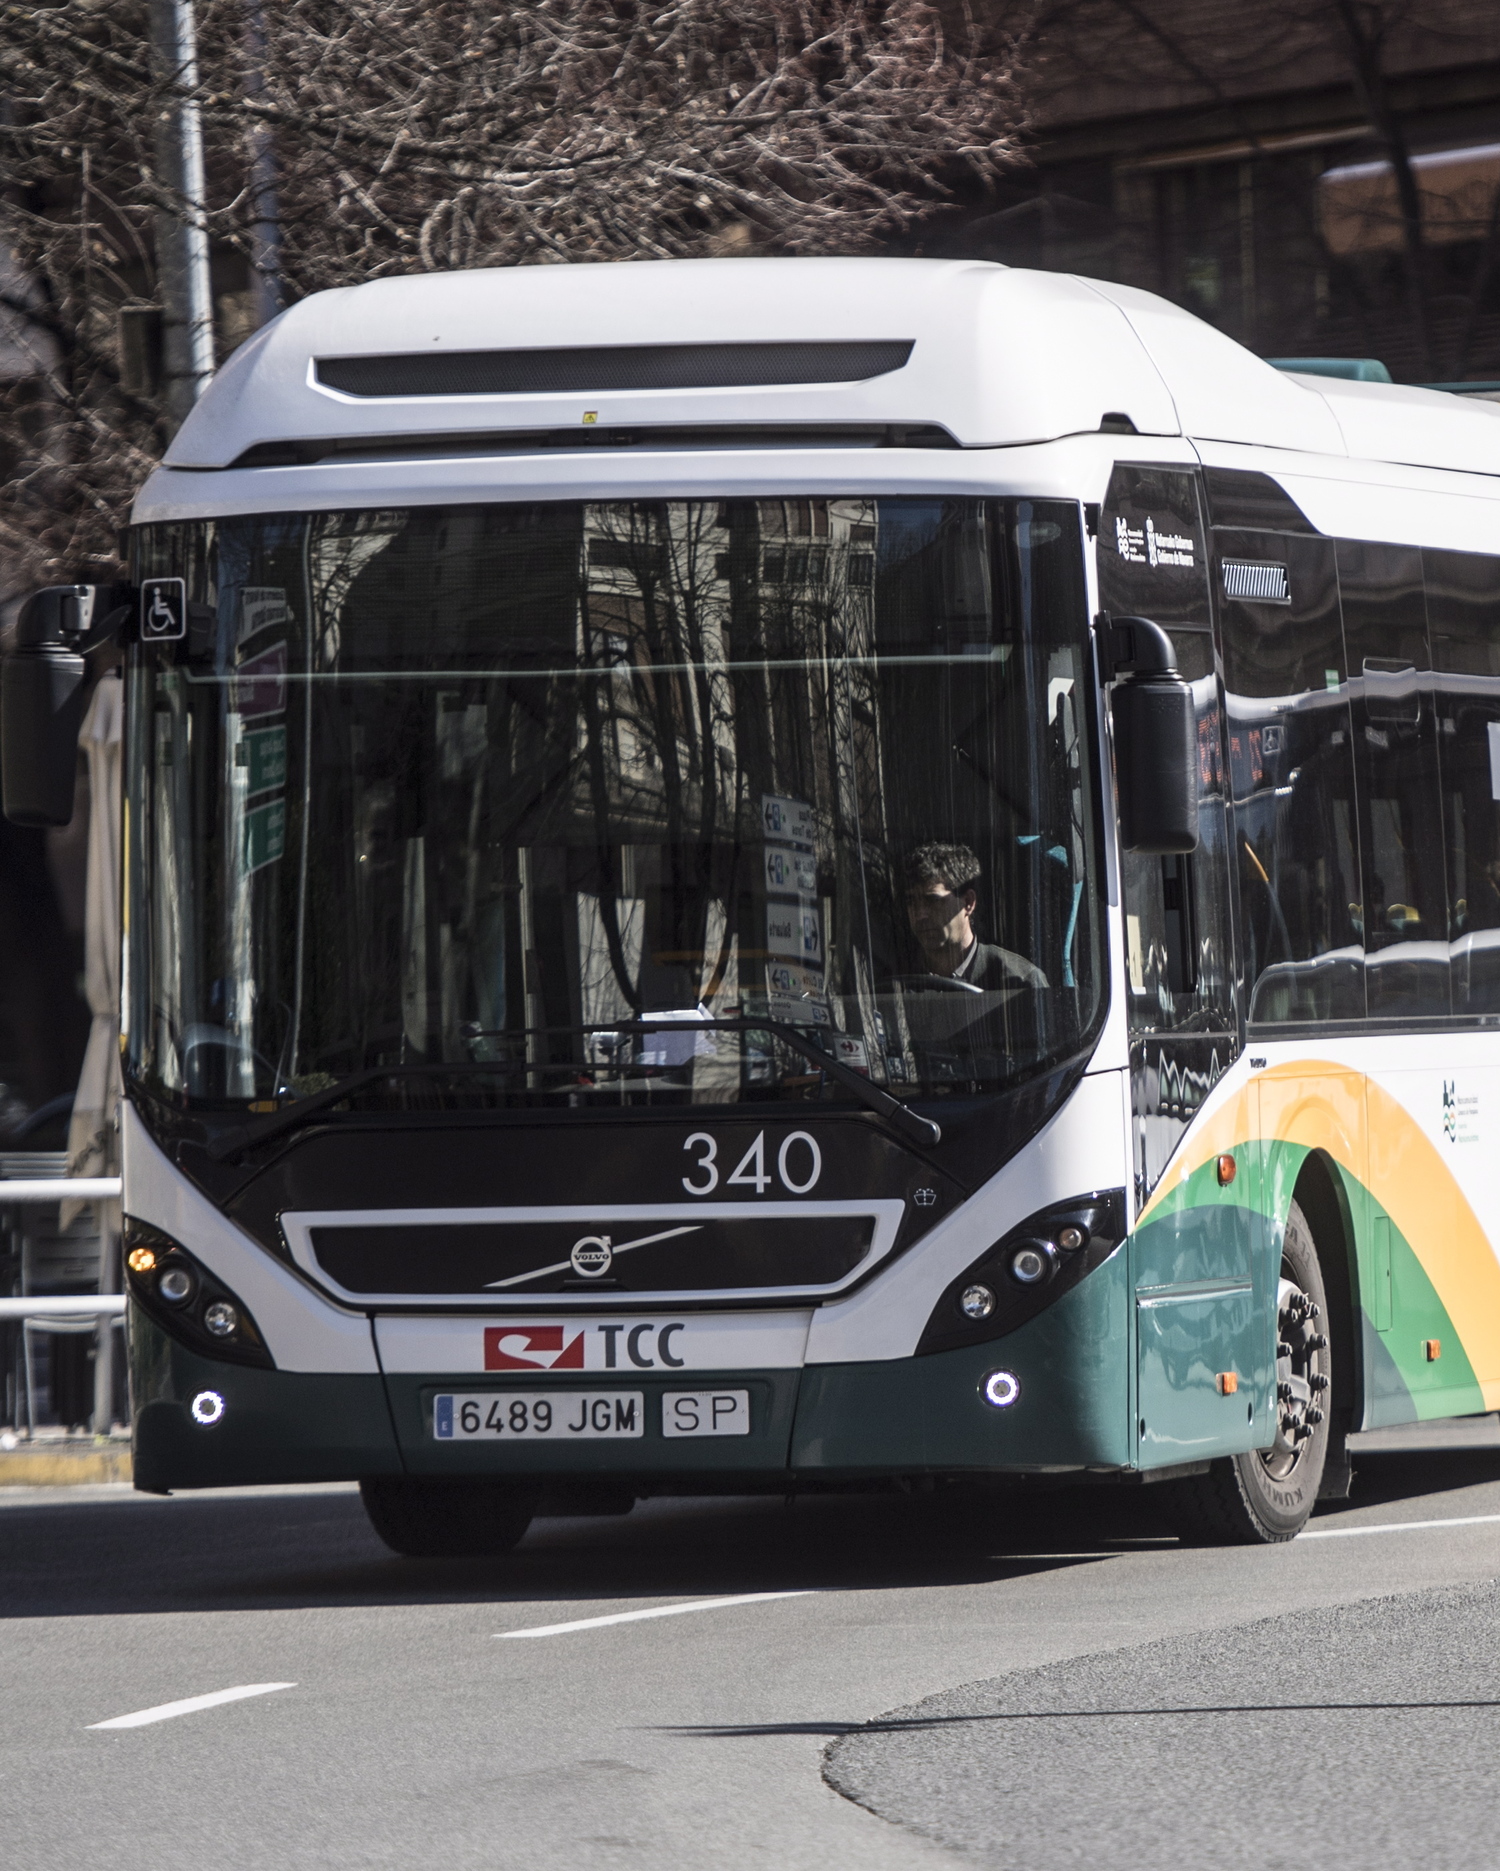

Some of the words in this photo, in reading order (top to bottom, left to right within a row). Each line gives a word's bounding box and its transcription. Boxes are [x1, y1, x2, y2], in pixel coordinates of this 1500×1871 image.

[682, 1129, 822, 1195] 340
[573, 1253, 610, 1261] VOLVO
[598, 1323, 685, 1368] TCC
[460, 1399, 553, 1434] 6489
[568, 1398, 636, 1432] JGM
